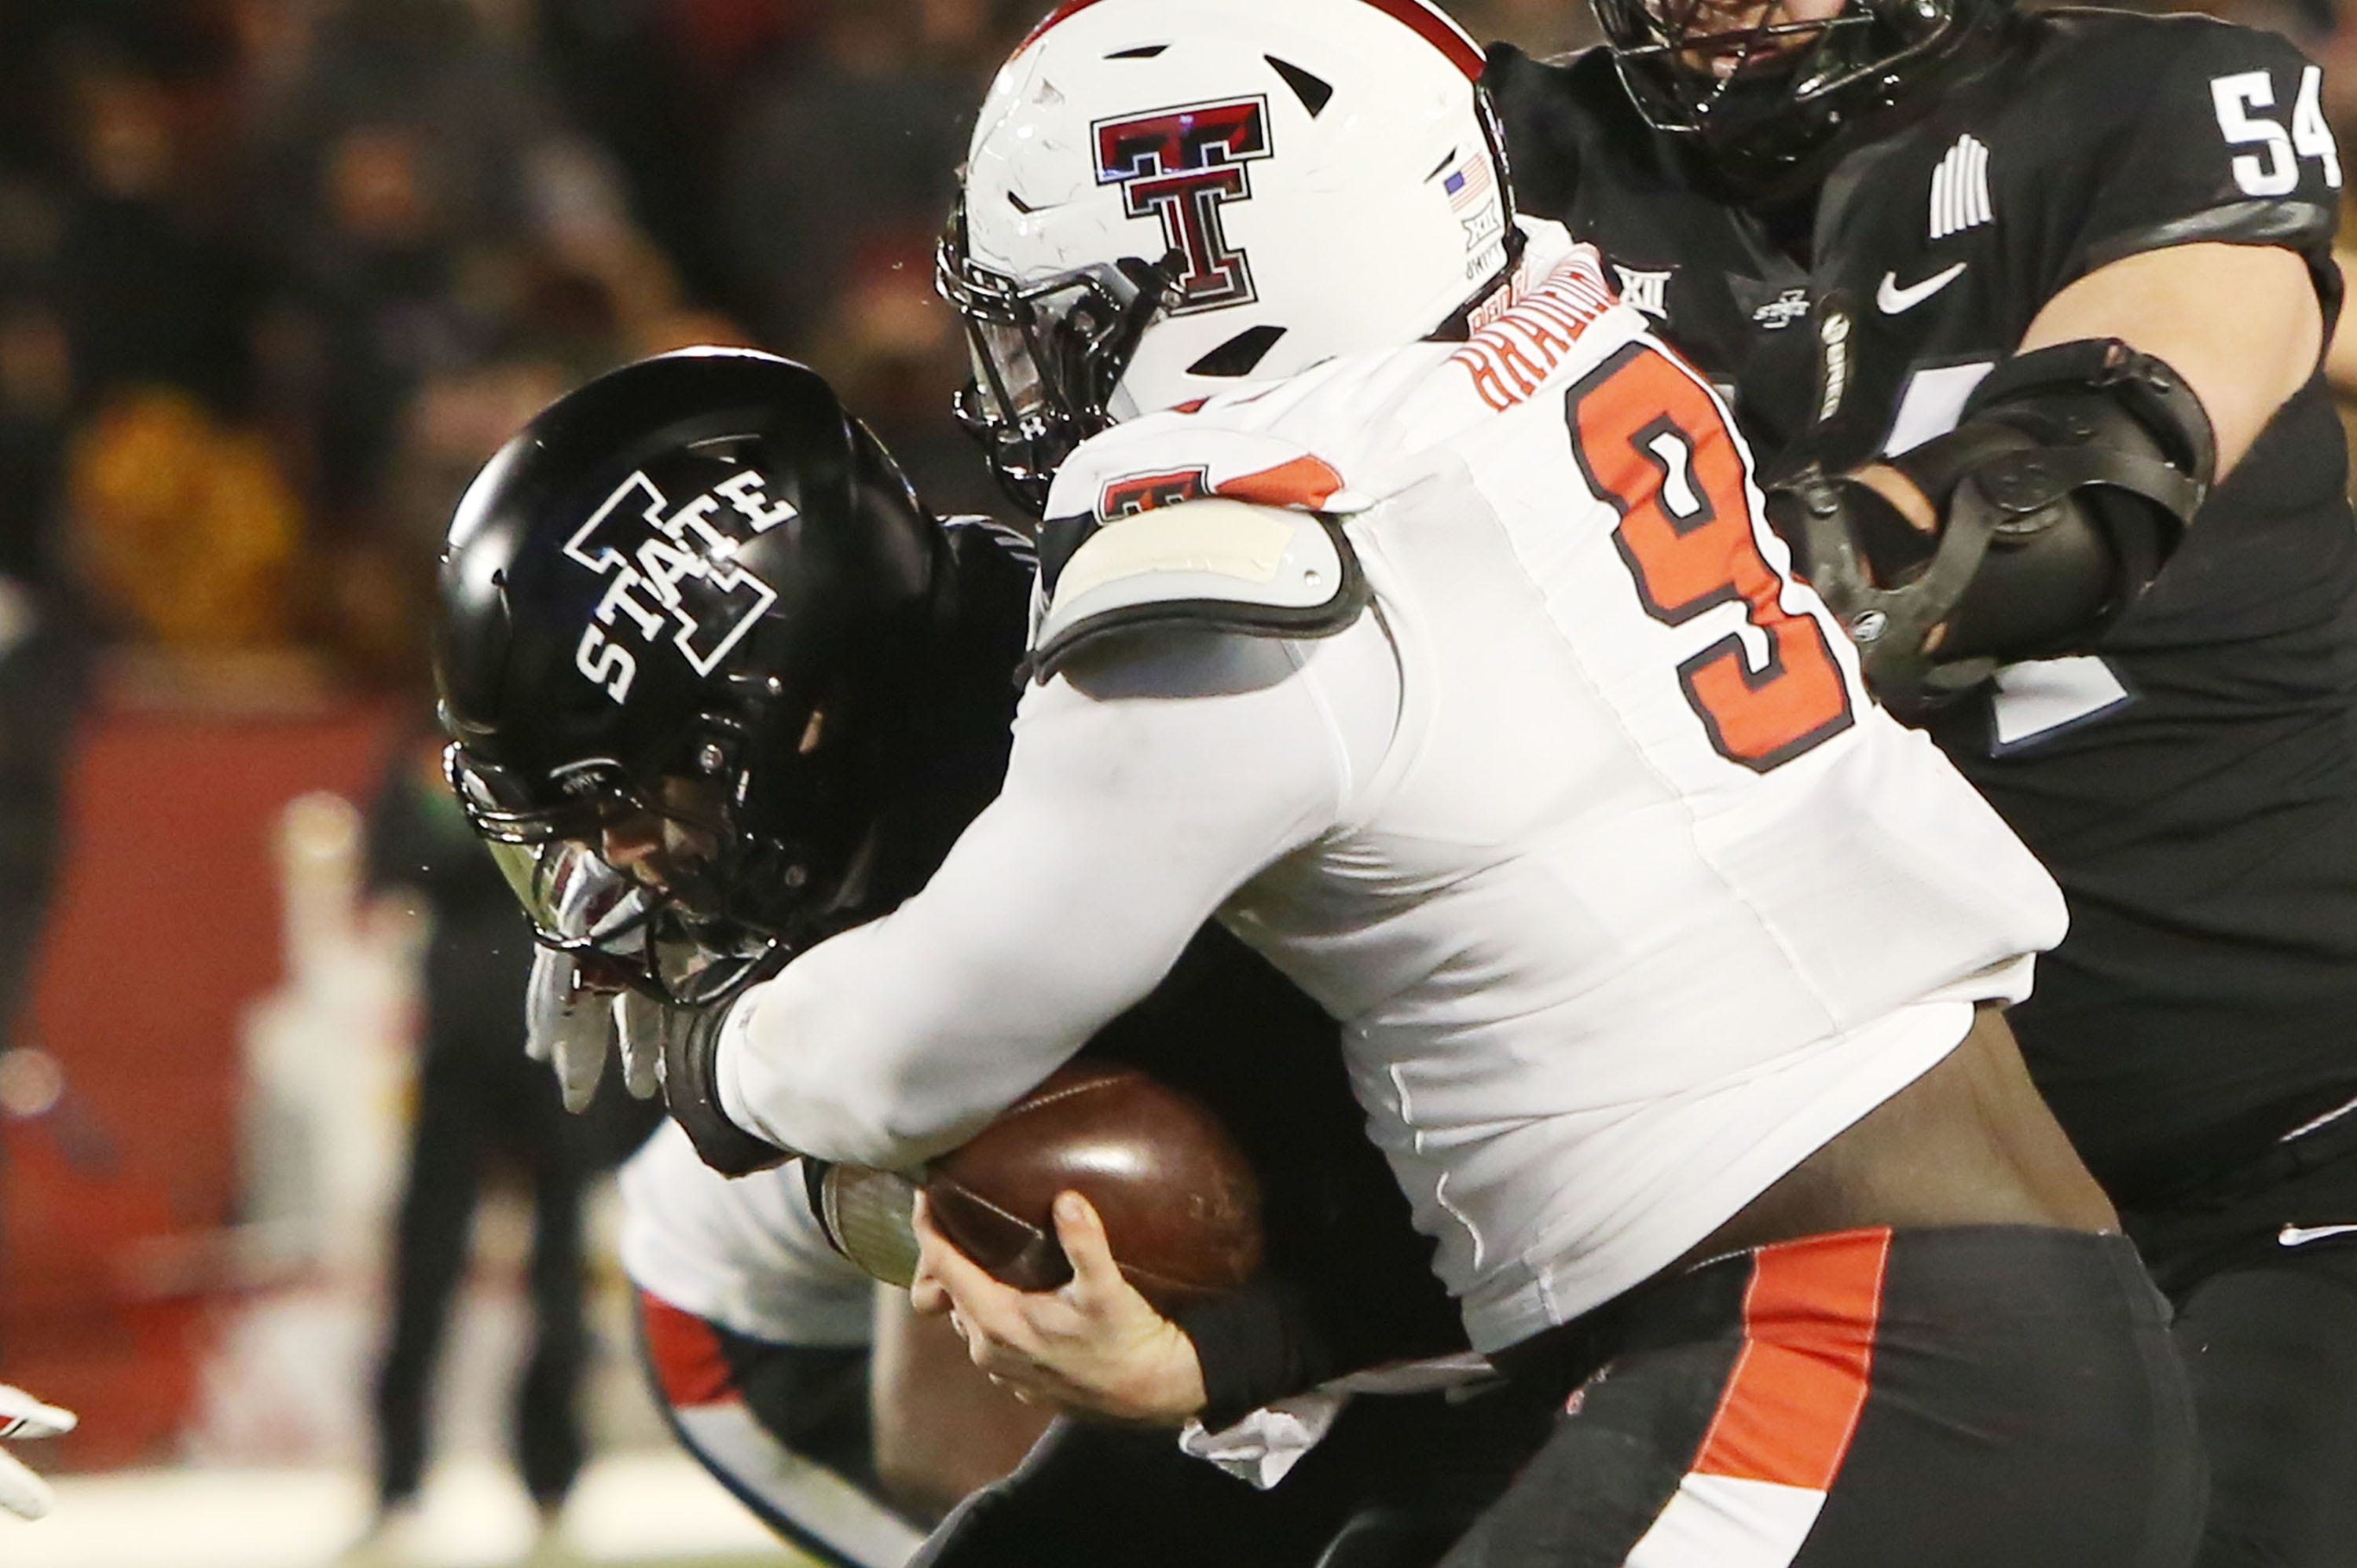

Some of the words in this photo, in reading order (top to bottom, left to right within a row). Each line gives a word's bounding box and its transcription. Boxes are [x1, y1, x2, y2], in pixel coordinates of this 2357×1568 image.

[2210, 64, 2344, 196] 54
[575, 470, 798, 705] STATE
[1565, 339, 1856, 775] 9
